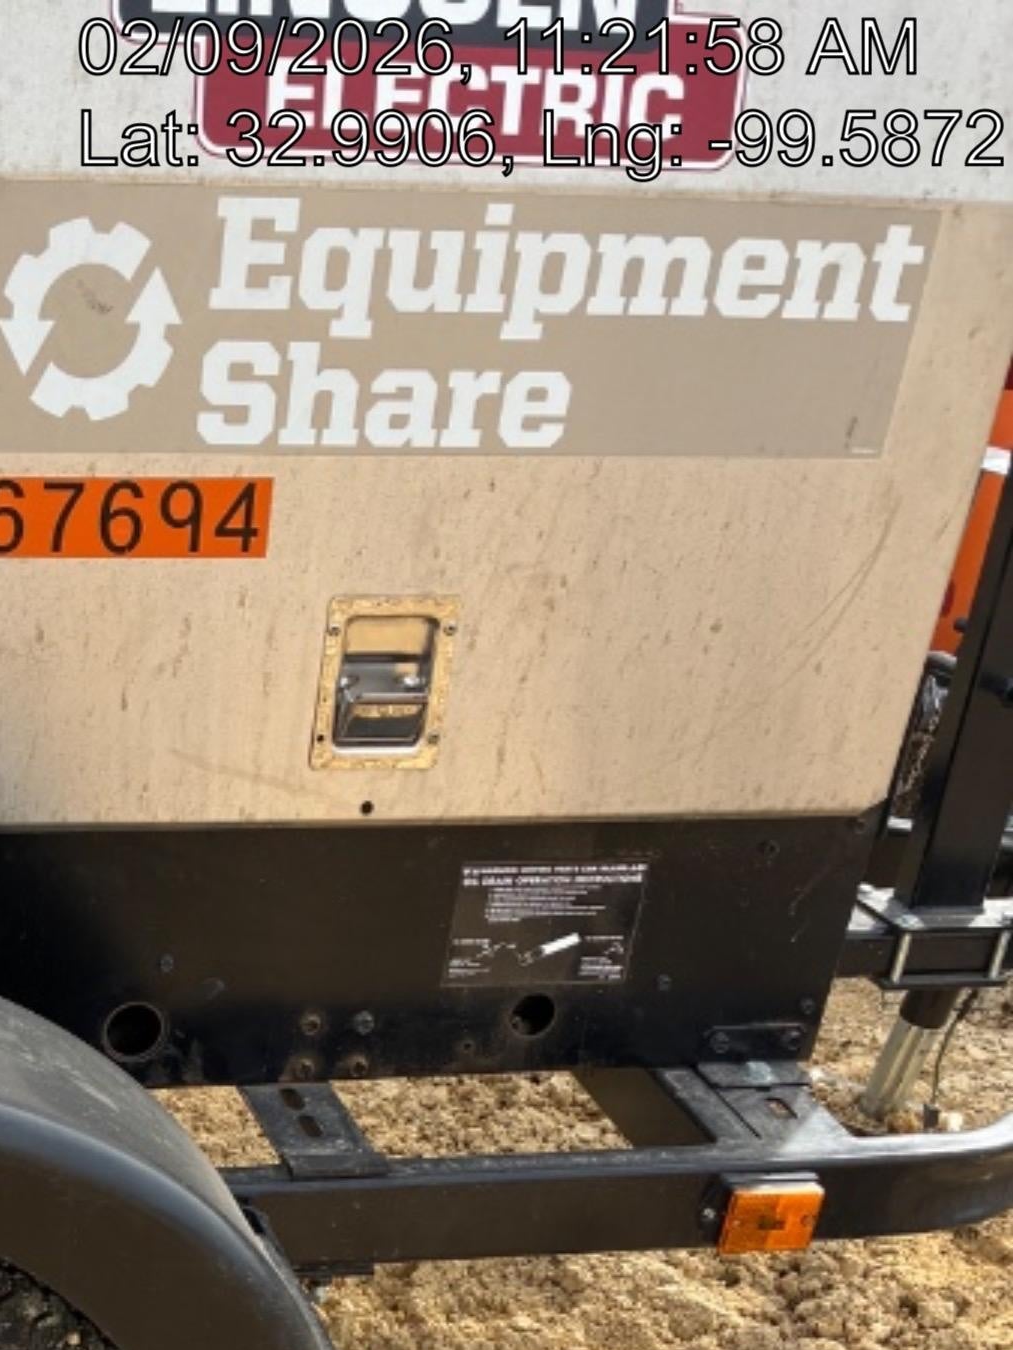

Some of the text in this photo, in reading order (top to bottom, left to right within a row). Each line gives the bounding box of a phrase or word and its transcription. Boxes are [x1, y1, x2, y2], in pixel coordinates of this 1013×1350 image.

[264, 56, 684, 141] ELECTRIC
[209, 197, 924, 340] Equipment
[196, 340, 572, 448] Share
